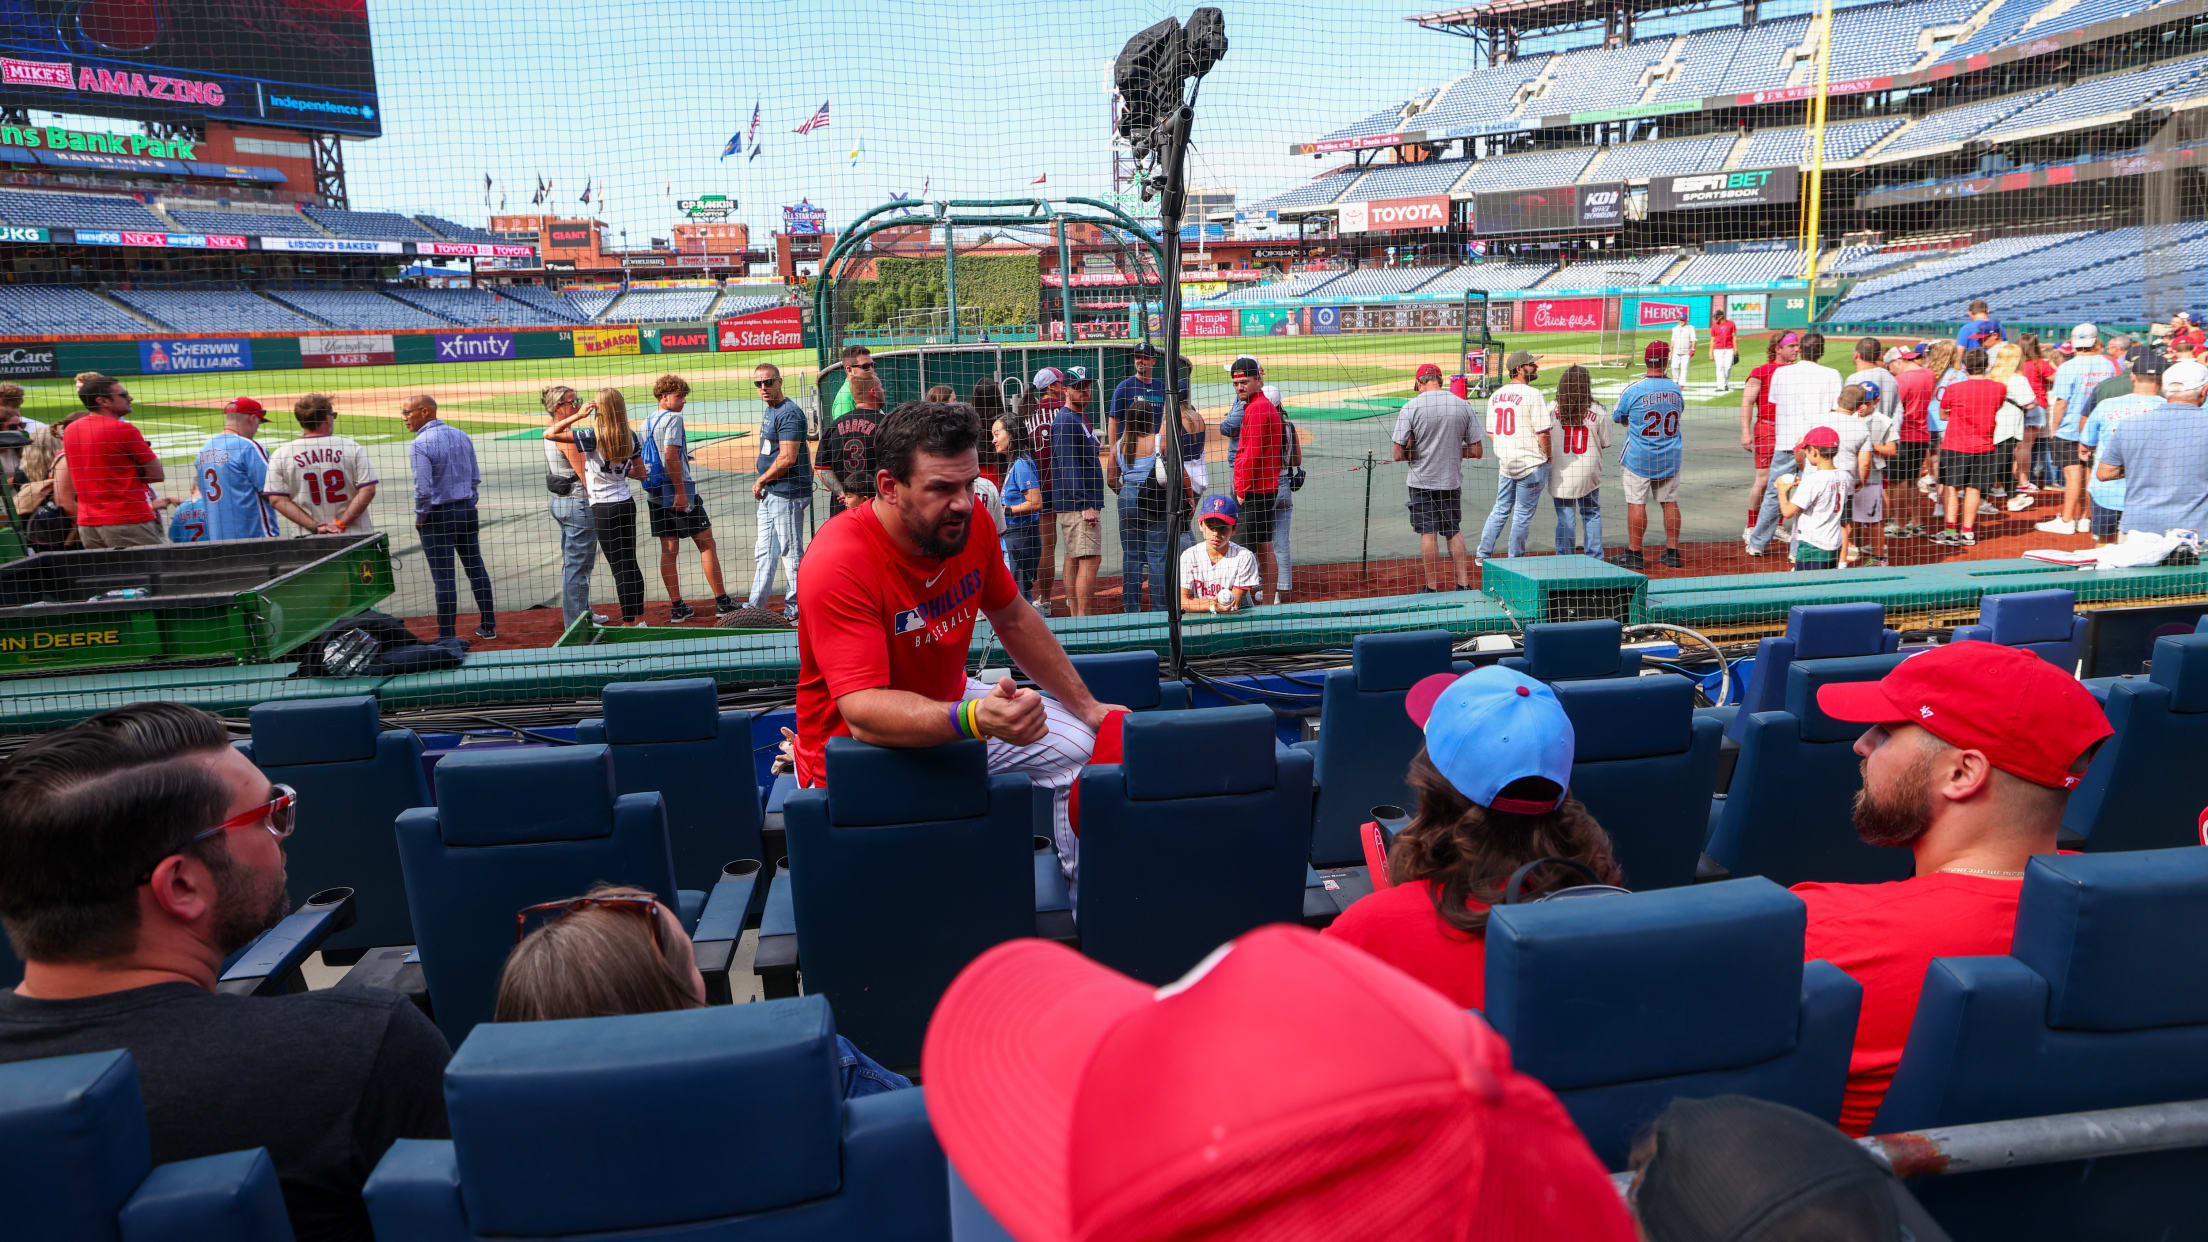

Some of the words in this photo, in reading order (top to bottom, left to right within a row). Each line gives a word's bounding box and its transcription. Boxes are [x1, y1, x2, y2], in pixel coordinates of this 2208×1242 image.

[10, 65, 67, 82] MIKE'S
[78, 67, 226, 107] AMAZING
[270, 95, 359, 116] Independence
[46, 126, 127, 155] Bank
[131, 134, 197, 160] Park
[1728, 170, 1773, 188] BET
[1683, 188, 1759, 202] SPORTSBOOK
[1372, 203, 1443, 223] TOYOTA
[124, 233, 163, 245] NECA
[209, 236, 246, 248] NECA
[338, 241, 379, 250] BAKERY
[437, 243, 476, 254] TOYOTA
[496, 247, 531, 256] TOYOTA
[1195, 314, 1228, 325] Temple
[1534, 303, 1596, 328] Chick-fil-A
[1643, 306, 1684, 320] HERR'S
[741, 331, 771, 346] State
[772, 331, 800, 344] Farm
[1195, 325, 1226, 335] Health
[171, 343, 239, 355] SHERWIN
[441, 335, 509, 358] xfinity
[661, 335, 708, 346] GIANT
[171, 355, 242, 369] WILLIAMS
[330, 354, 369, 364] LAGER
[837, 418, 876, 436] HARPER
[1495, 407, 1515, 436] 10
[1641, 410, 1680, 437] 20
[1562, 425, 1589, 455] 10
[295, 448, 343, 468] STAIRS
[843, 438, 867, 474] 3
[204, 467, 222, 502] 3
[303, 469, 347, 505] 12
[184, 523, 205, 542] 7
[919, 568, 982, 624] PHILLIES
[915, 607, 972, 648] BASEBALL
[34, 630, 120, 648] DEERE
